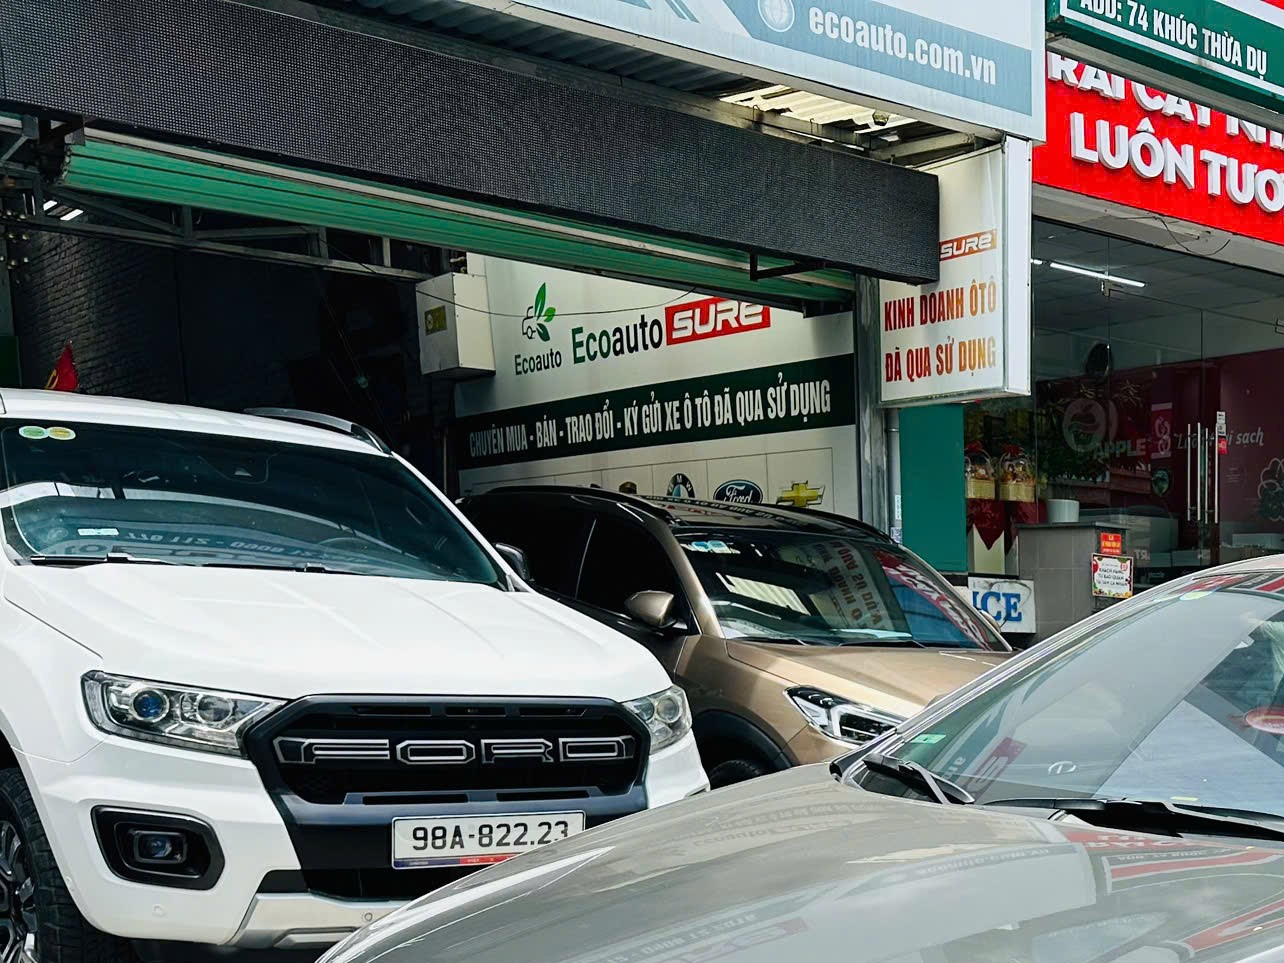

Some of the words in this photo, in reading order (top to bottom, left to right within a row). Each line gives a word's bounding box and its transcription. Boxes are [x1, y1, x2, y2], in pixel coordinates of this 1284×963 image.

[809, 7, 996, 85] ecoauto.com.vn
[1127, 0, 1148, 31] 74
[1153, 9, 1198, 49] KHÚC
[1202, 29, 1242, 67] THỪA
[1246, 45, 1267, 81] DỤ
[1070, 112, 1195, 190] LUÔN
[940, 232, 992, 259] SURE
[884, 297, 915, 332] KINH
[920, 287, 964, 325] DOANH
[969, 275, 997, 317] ÔTÔ
[572, 314, 663, 365] Ecoauto
[671, 301, 764, 339] SURE
[906, 346, 932, 383] QUA
[936, 336, 955, 376] SỬ
[958, 336, 996, 377] DỤNG
[514, 348, 562, 376] Ecoauto
[469, 423, 504, 457] CHUYÊN
[506, 423, 528, 453] MUA
[536, 414, 557, 448] BÁN
[565, 413, 593, 444] TRAO
[595, 399, 614, 440] ĐỔI
[624, 400, 639, 436] KÝ
[641, 391, 662, 434] GỬI
[664, 400, 681, 431] XE
[684, 392, 693, 429] Ô
[694, 389, 712, 428] TÔ
[714, 387, 733, 426] ĐÃ
[735, 389, 764, 427] QUA
[767, 372, 787, 419] SỬ
[790, 379, 831, 423] DỤNG
[273, 734, 637, 765] FORD
[411, 820, 569, 851] 98A-822.23
